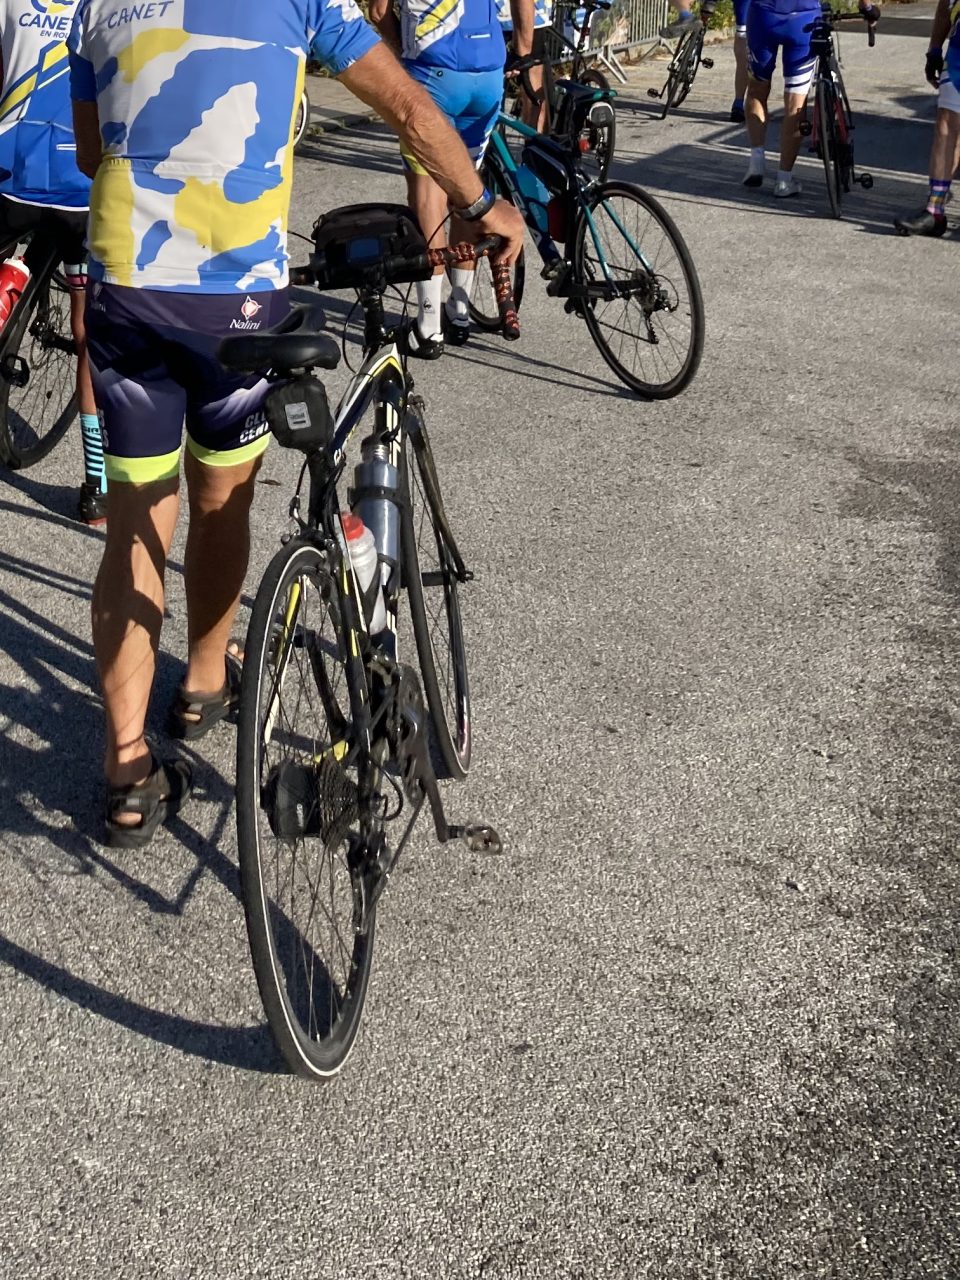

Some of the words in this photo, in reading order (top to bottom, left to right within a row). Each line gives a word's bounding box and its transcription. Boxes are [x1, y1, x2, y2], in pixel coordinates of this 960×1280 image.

[19, 12, 73, 31] CANE
[107, 0, 175, 29] CANET
[229, 318, 262, 331] Nalini
